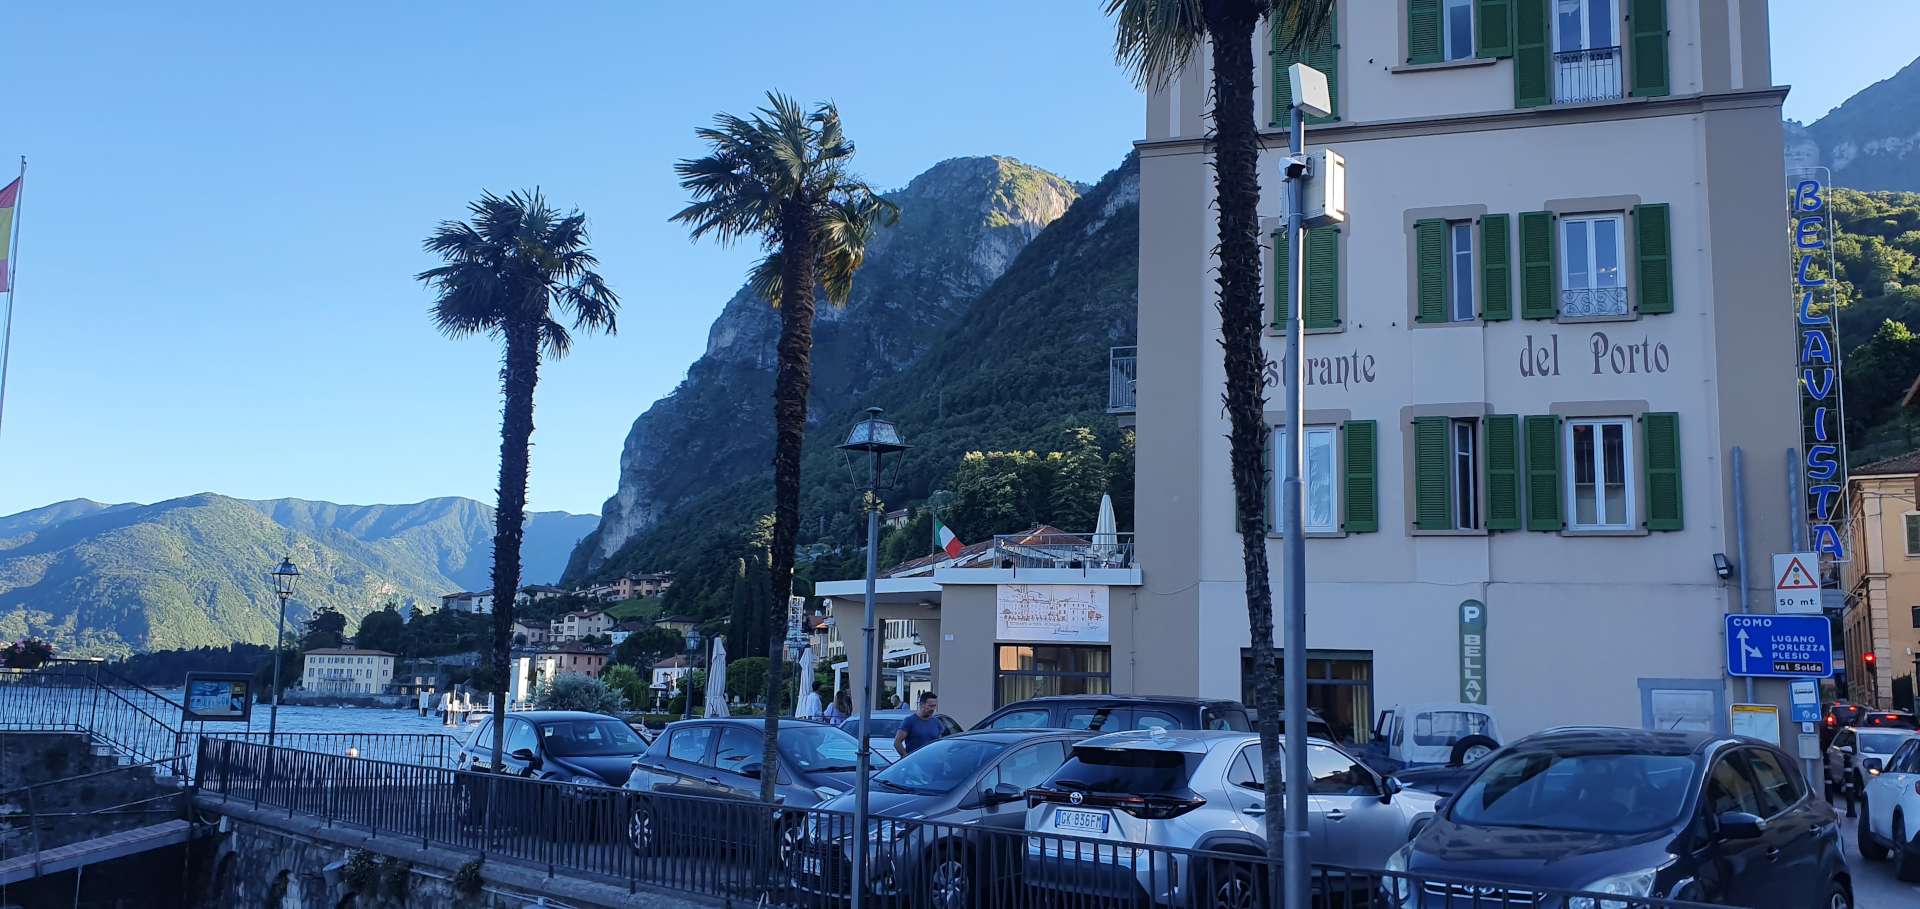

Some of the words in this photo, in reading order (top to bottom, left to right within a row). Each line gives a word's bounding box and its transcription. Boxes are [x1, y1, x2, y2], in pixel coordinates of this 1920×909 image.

[1264, 347, 1376, 393] strante
[1519, 334, 1560, 377] del
[1589, 331, 1669, 375] Porto
[1794, 180, 1844, 559] BELLAVISTA
[1780, 598, 1794, 606] 50
[1464, 606, 1480, 623] P
[1733, 618, 1772, 627] COMO
[1771, 635, 1816, 643] LUGANO
[1771, 643, 1826, 652] PORLEZZA
[1772, 652, 1810, 660] PLESIO
[1464, 634, 1481, 702] BELLAV
[1794, 663, 1822, 672] Solda
[1061, 812, 1072, 825] GK
